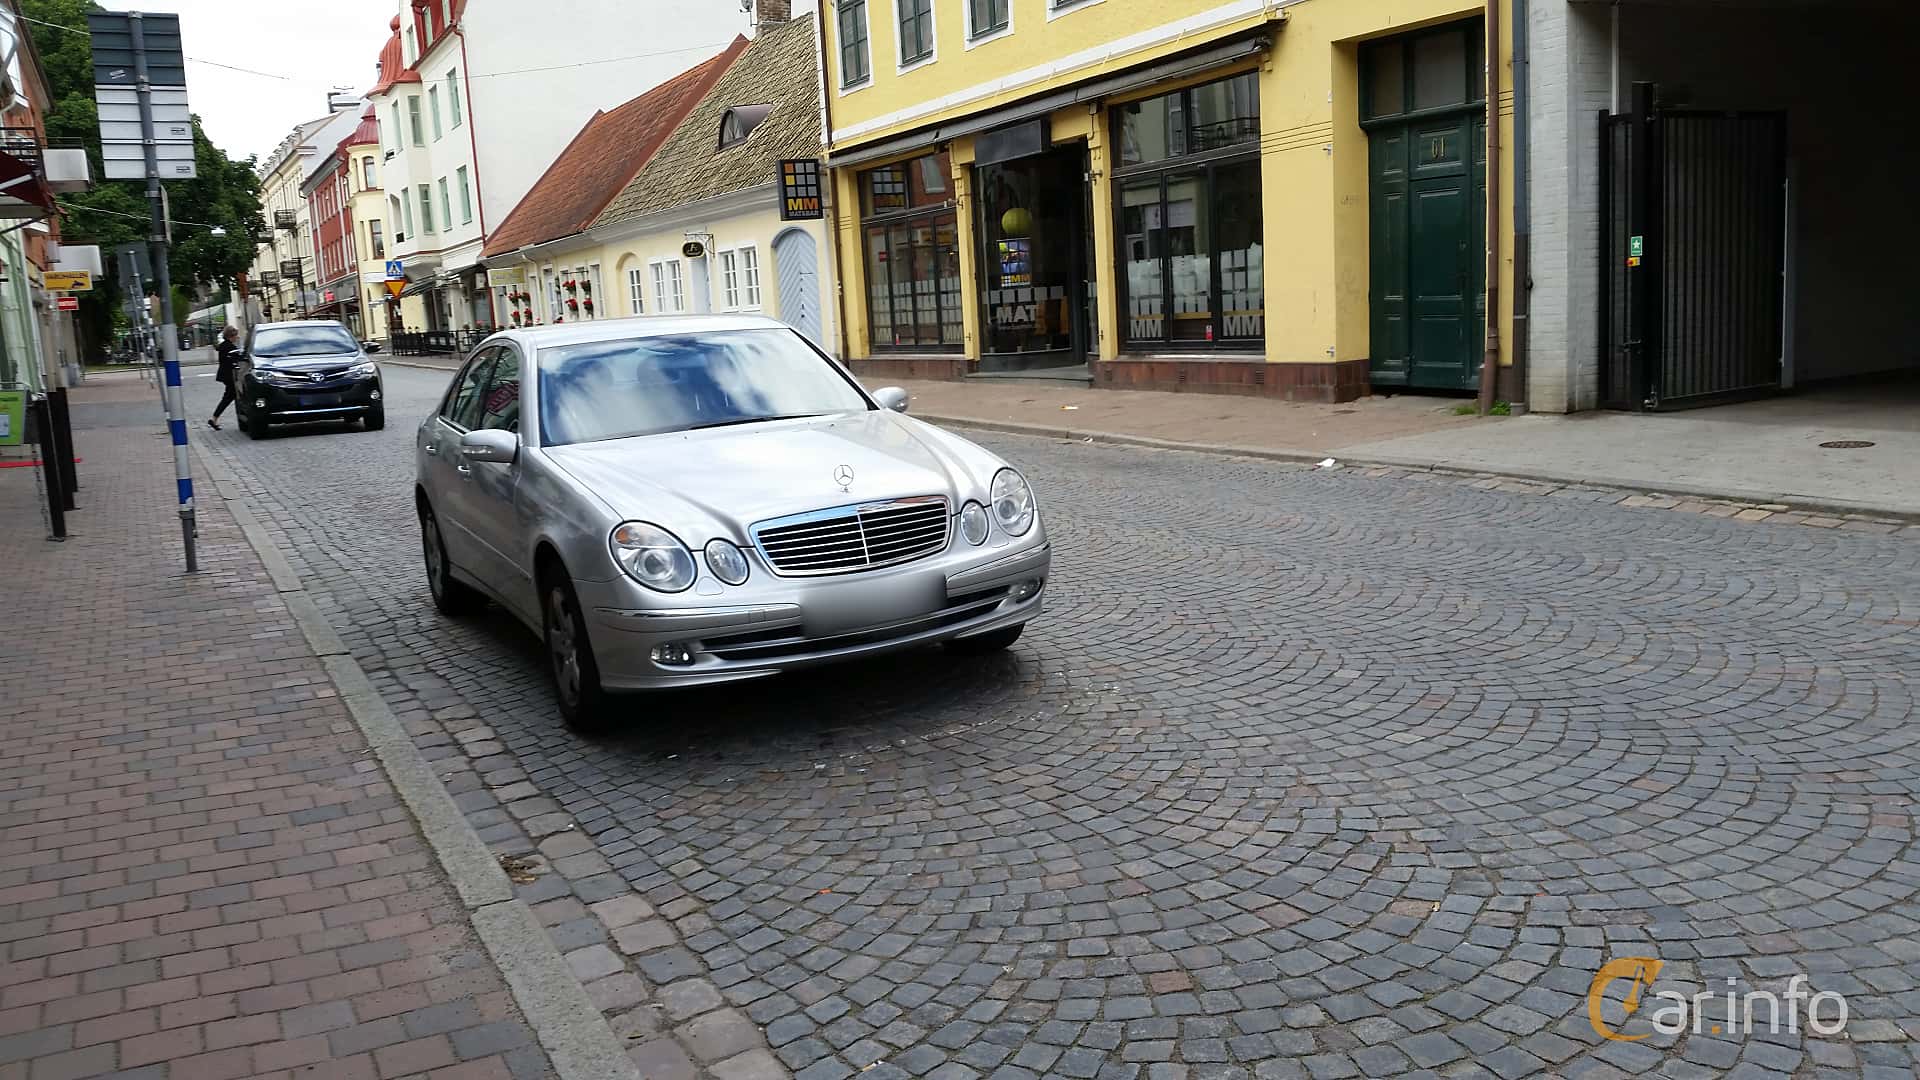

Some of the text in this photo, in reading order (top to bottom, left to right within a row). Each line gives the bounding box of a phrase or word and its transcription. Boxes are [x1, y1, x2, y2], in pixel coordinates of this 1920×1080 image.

[788, 198, 819, 210] MM
[996, 304, 1039, 323] MAT
[1131, 319, 1163, 339] MM
[1223, 315, 1262, 337] MM
